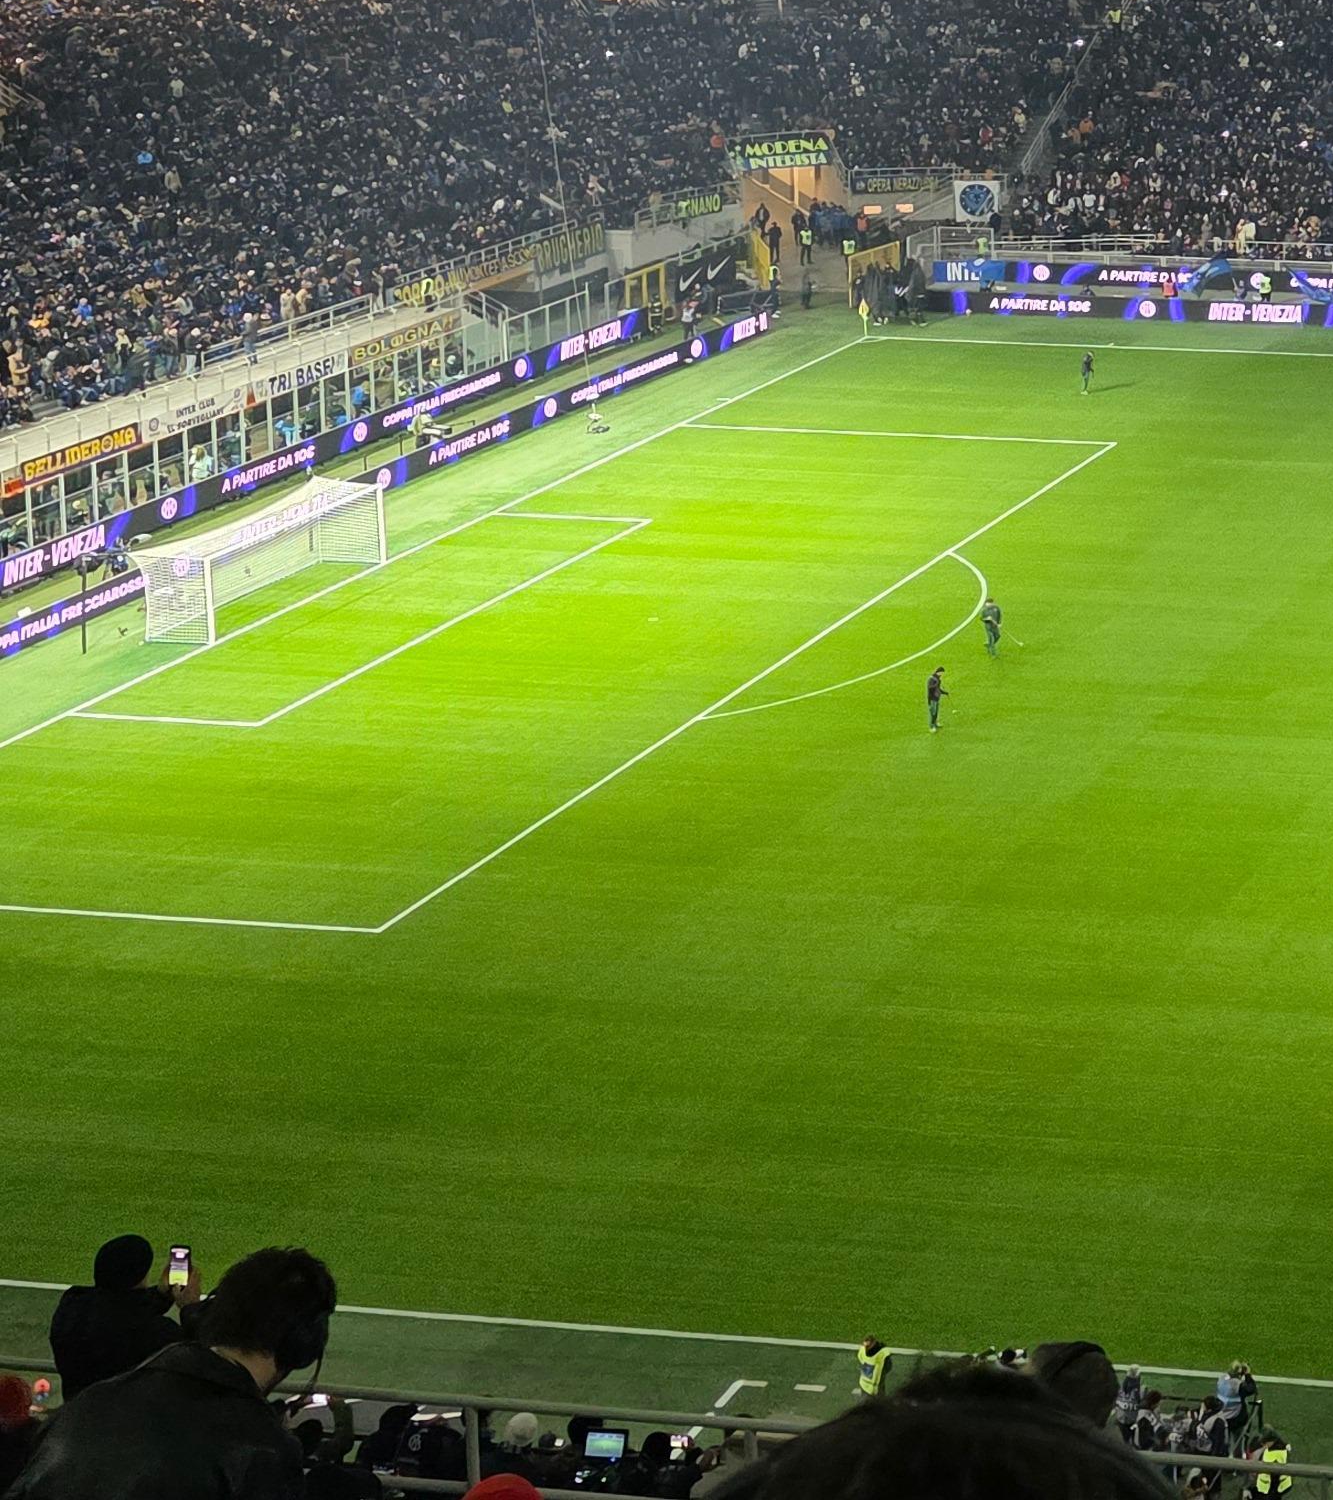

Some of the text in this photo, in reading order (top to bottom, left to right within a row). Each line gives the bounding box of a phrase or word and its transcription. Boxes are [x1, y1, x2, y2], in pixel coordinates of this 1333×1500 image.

[744, 137, 829, 157] MODENA
[749, 152, 828, 169] INTERISTA
[867, 179, 891, 193] OPERA
[537, 222, 605, 272] BRUGHERIO
[1098, 271, 1110, 283] A
[1110, 270, 1161, 284] PARTIRE
[990, 298, 1001, 310] A
[1001, 299, 1048, 312] PARTIRE
[1049, 301, 1067, 312] DA
[354, 322, 441, 361] BOLOGNA
[268, 372, 292, 395] TRI
[175, 397, 216, 418] INTER CLUB
[428, 451, 438, 465] A
[438, 432, 476, 461] PARTIRE
[477, 429, 491, 445] DA
[221, 480, 232, 495] A
[232, 461, 277, 492] PARTIRE
[277, 455, 293, 474] DA
[20, 614, 61, 642] ITALIA
